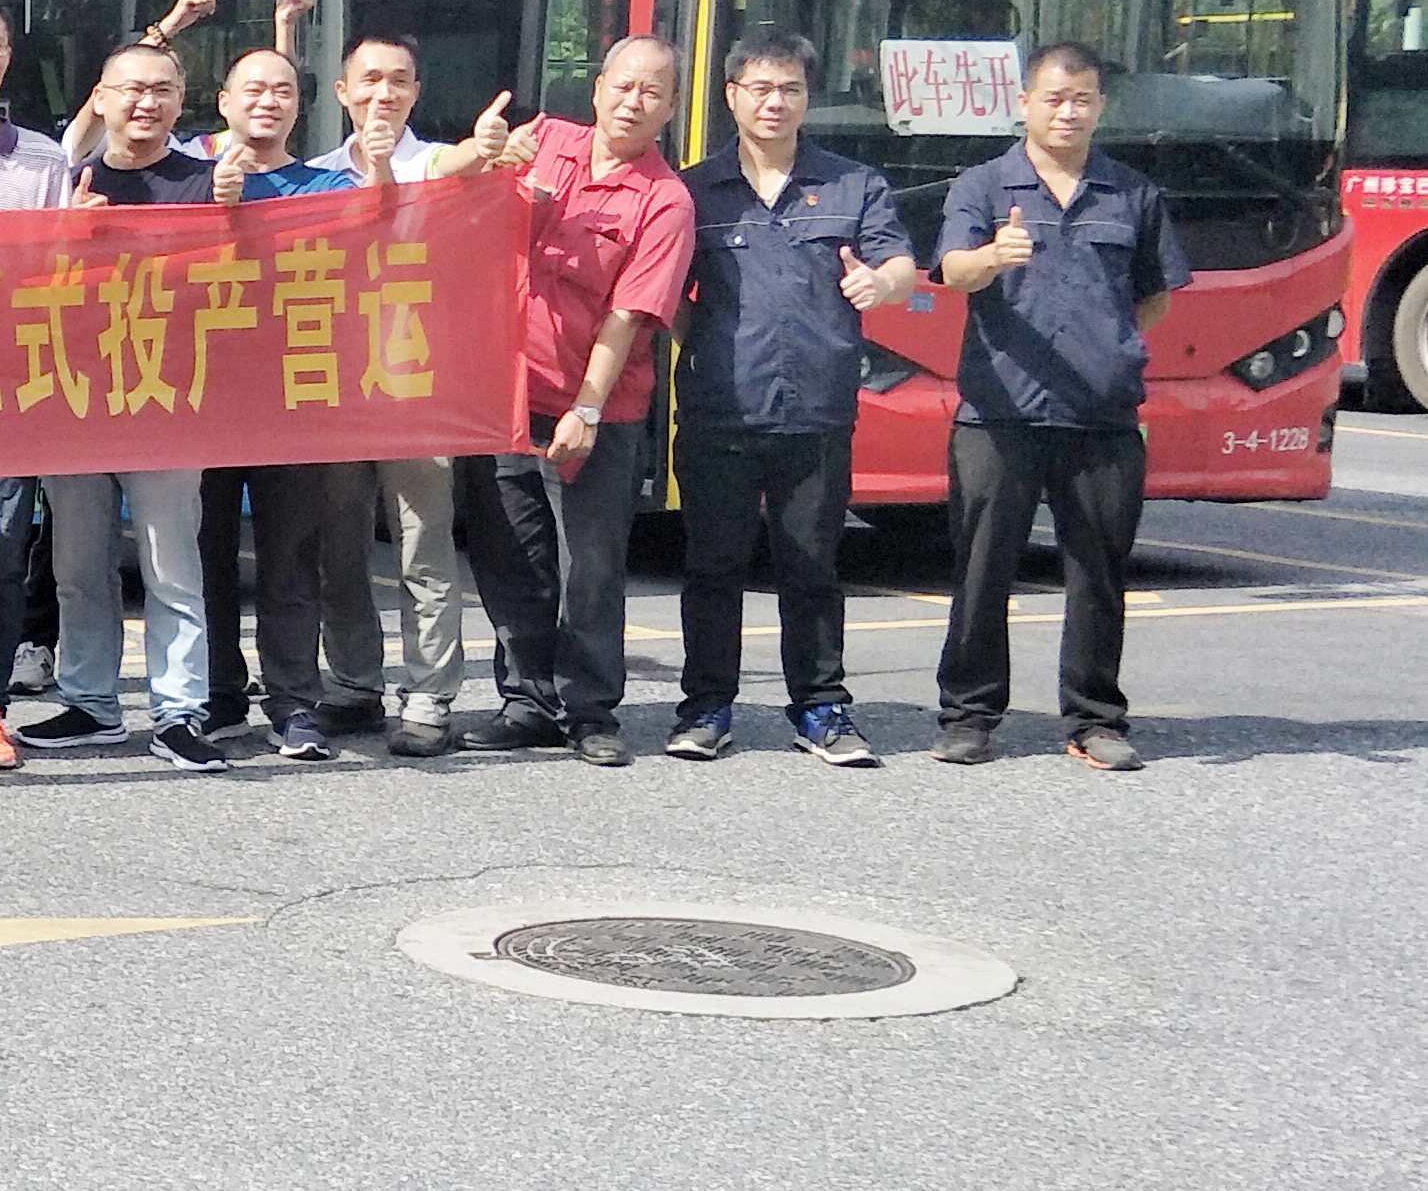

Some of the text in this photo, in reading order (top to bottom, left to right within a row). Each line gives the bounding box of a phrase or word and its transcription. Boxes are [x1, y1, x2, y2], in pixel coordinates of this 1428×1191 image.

[888, 49, 1015, 118] 此车先开
[1221, 426, 1309, 454] 3-4-1228
